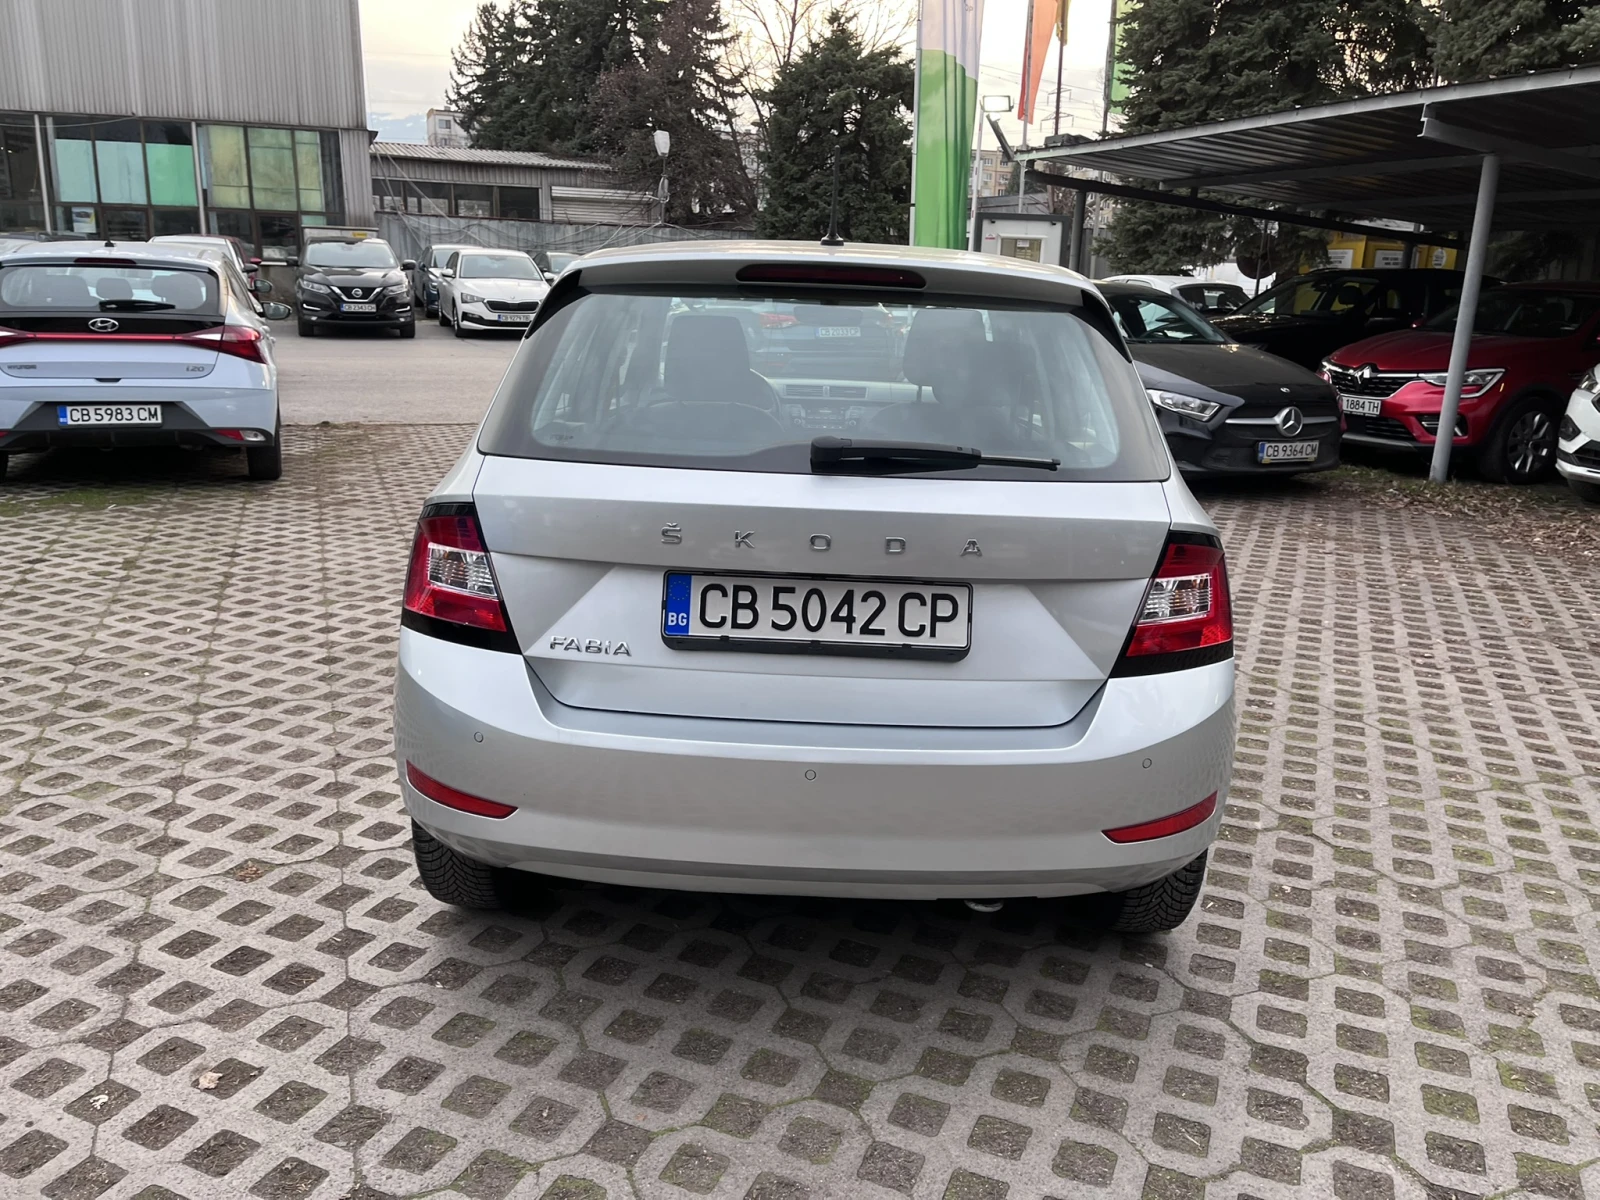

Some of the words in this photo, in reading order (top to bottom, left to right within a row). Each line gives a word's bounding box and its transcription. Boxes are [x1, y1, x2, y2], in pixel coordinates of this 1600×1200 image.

[820, 327, 830, 336] CB
[831, 327, 848, 336] 2033
[1346, 398, 1365, 411] 1884
[1367, 401, 1380, 413] TH
[69, 408, 91, 422] CB
[94, 407, 134, 422] 5983
[137, 407, 159, 421] CM
[1266, 445, 1280, 458] CB
[1281, 444, 1305, 457] 9364
[1305, 443, 1318, 456] CM
[660, 522, 983, 557] ŠKODA
[667, 612, 687, 626] BG
[699, 583, 759, 630] CB
[770, 585, 887, 636] 5042
[897, 592, 959, 638] CP
[549, 635, 632, 657] FABIA
